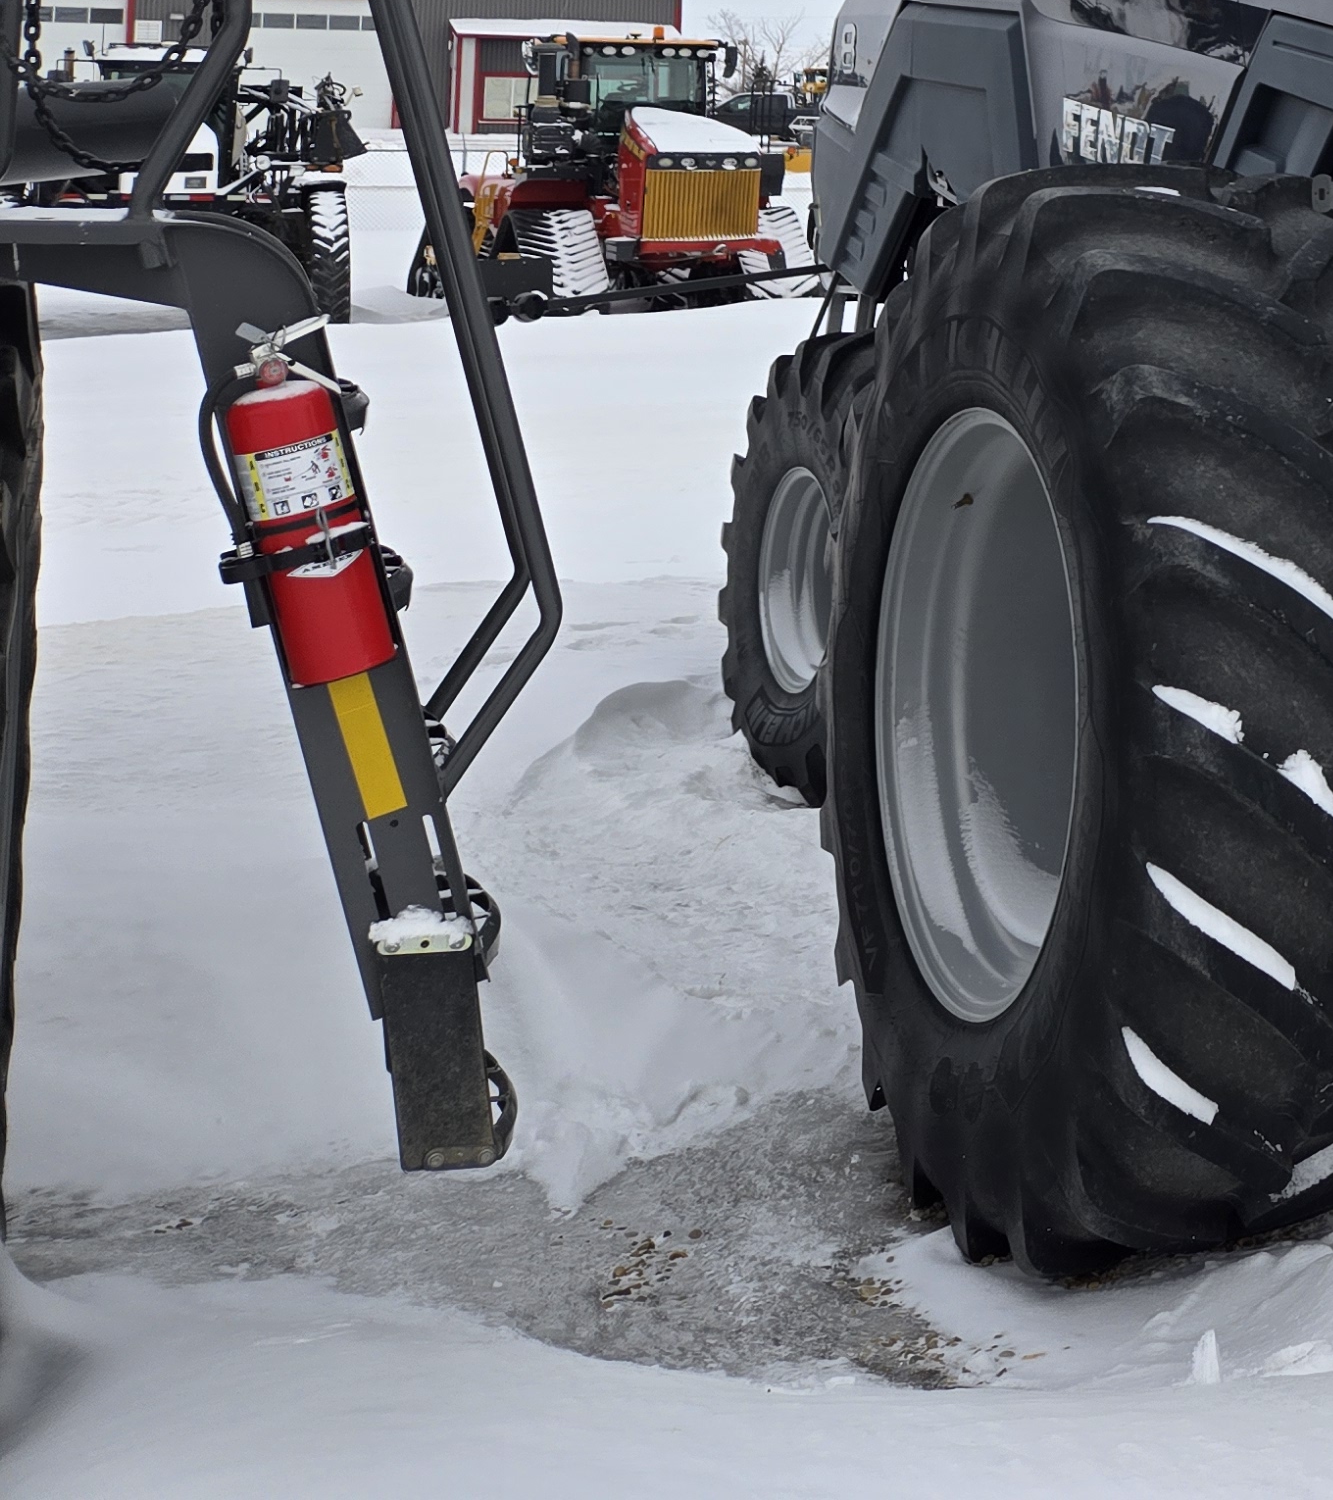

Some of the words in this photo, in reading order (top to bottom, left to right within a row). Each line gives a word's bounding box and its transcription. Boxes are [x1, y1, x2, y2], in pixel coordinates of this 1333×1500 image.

[841, 23, 857, 74] 8
[1063, 97, 1176, 164] FENDT
[264, 436, 328, 459] INSTRUCTIONS
